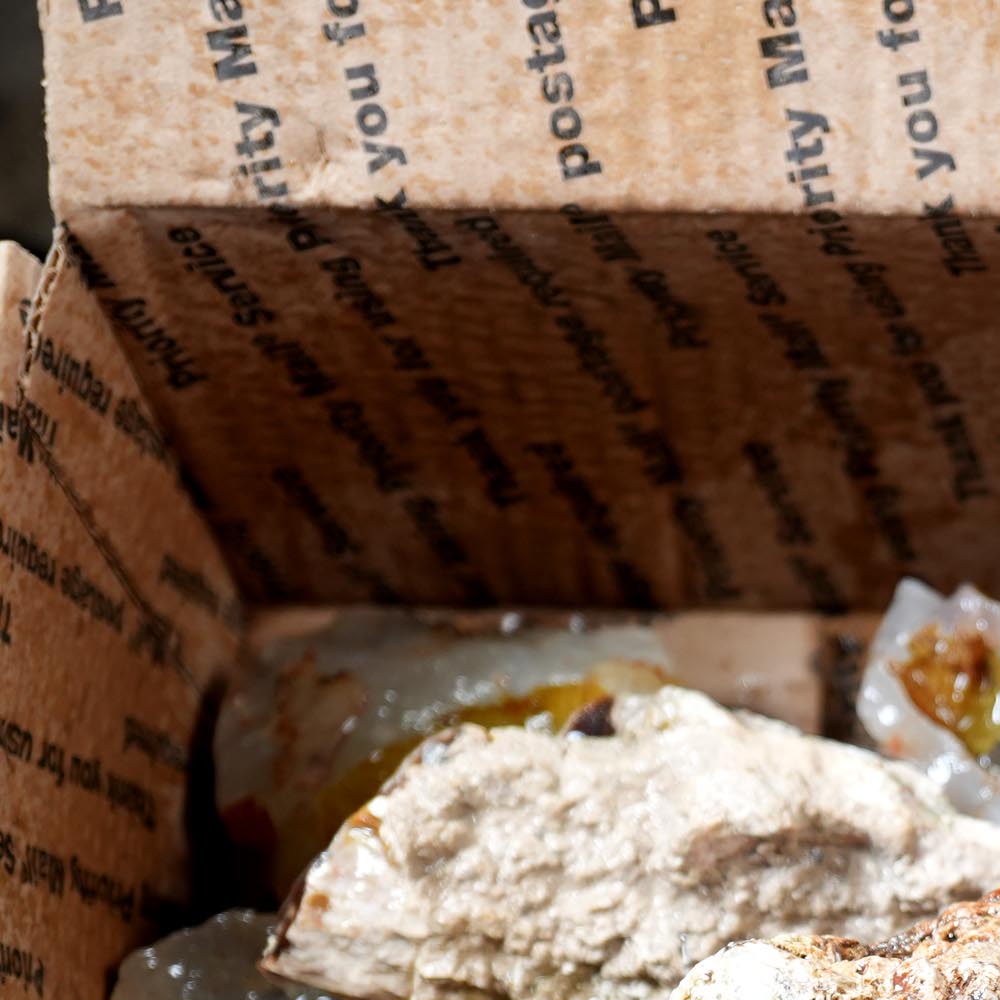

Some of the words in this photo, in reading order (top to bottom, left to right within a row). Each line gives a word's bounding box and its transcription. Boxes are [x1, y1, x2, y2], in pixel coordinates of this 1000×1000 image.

[877, 0, 920, 51] fo
[344, 63, 408, 174] you
[524, 0, 602, 181] posta
[897, 70, 956, 181] you
[168, 226, 276, 328] Service
[454, 215, 573, 308] required
[704, 228, 790, 308] Service
[918, 195, 992, 279] Thank
[320, 254, 400, 331] using
[843, 260, 909, 319] using
[37, 739, 67, 788] for
